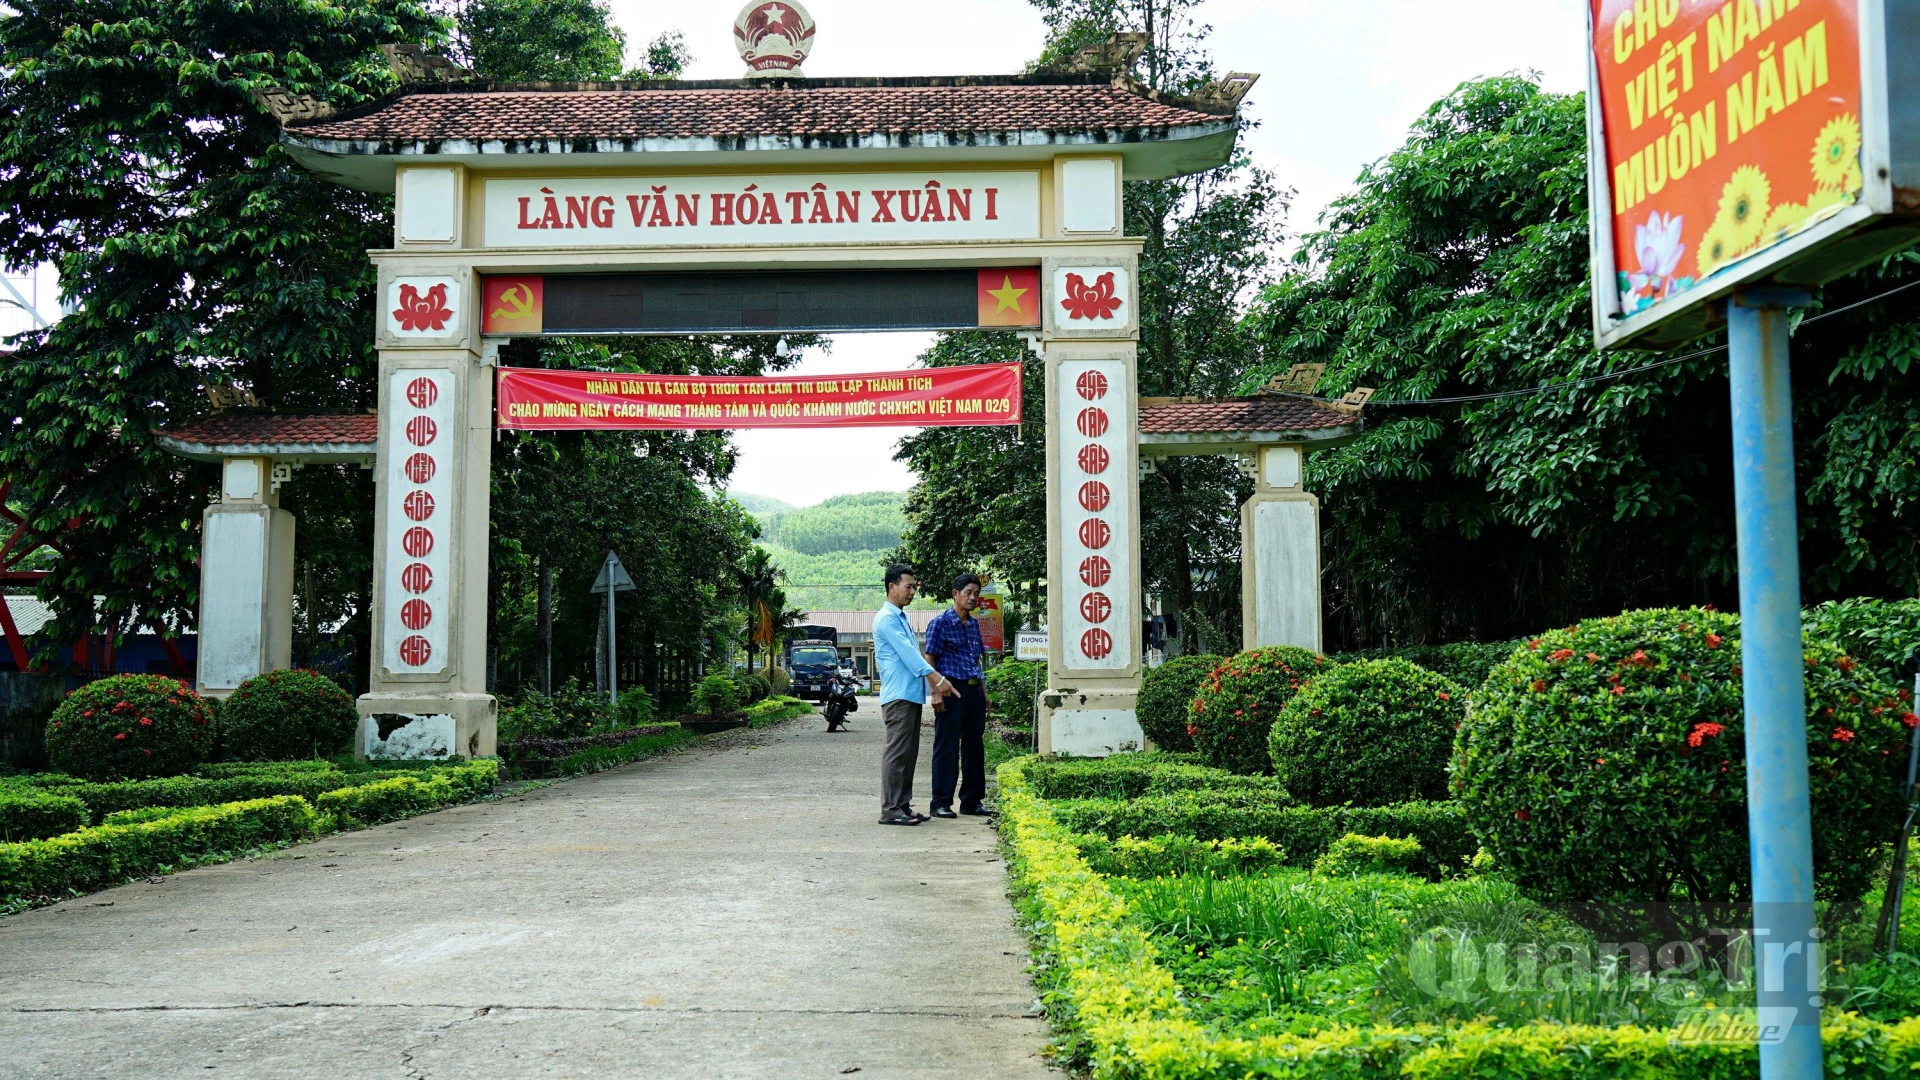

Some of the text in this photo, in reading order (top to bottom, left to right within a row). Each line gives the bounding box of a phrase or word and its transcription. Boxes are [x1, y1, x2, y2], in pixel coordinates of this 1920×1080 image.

[1624, 31, 1697, 131] VIỆT
[1614, 19, 1829, 215] MUÔN NĂM
[517, 179, 998, 230] LÀNG VĂN HÓA TÂN XUÂN I
[509, 397, 1010, 420] CHÀO MỪNG NGÀY CÁCH MẠNG THÁNG TÁM VÀ QUỐC KHÁNH NƯỚC CHXHCN VIỆT NAM 02/9
[586, 379, 618, 395] NHÂN
[621, 380, 645, 395] DÂN
[796, 381, 813, 394] THI
[817, 381, 839, 394] ĐUA
[842, 379, 863, 396] LẬP
[866, 377, 904, 392] THÀNH
[907, 375, 932, 391] TÍCH
